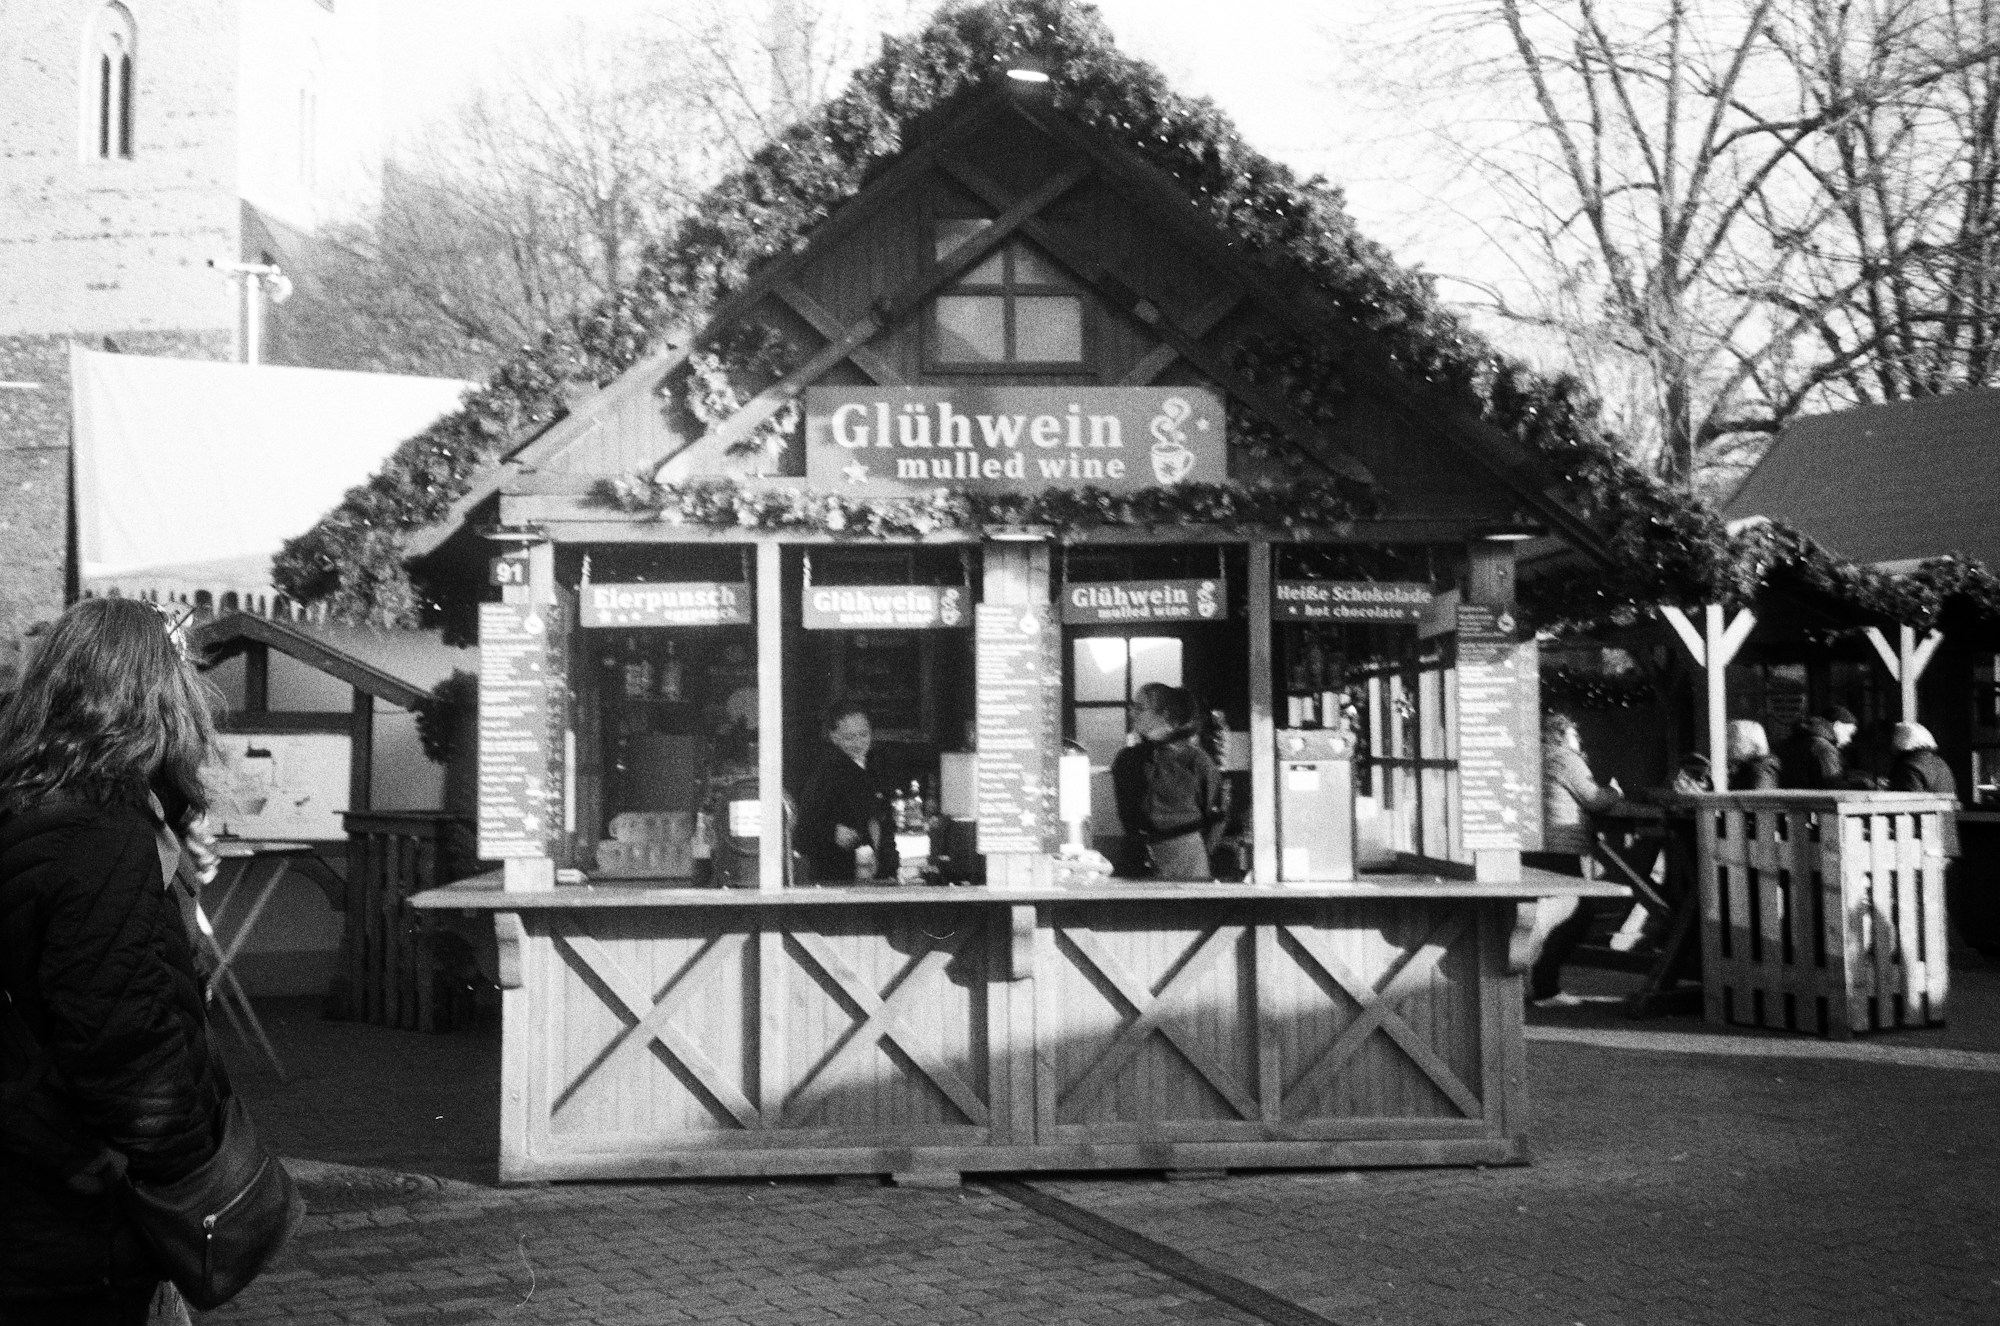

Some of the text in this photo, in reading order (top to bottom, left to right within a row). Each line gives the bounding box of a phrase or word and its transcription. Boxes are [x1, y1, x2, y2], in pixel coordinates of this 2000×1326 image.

[831, 402, 1124, 449] Glühwein
[897, 452, 1126, 479] mulled wine
[496, 562, 523, 583] 91
[594, 586, 736, 613] Eierpunsch
[813, 590, 932, 612] Glühwein
[1071, 585, 1189, 607] Glühwein
[1276, 585, 1433, 603] Heiße Schokolade
[1098, 605, 1190, 618] mulled wine
[1305, 604, 1404, 619] hot chocolate
